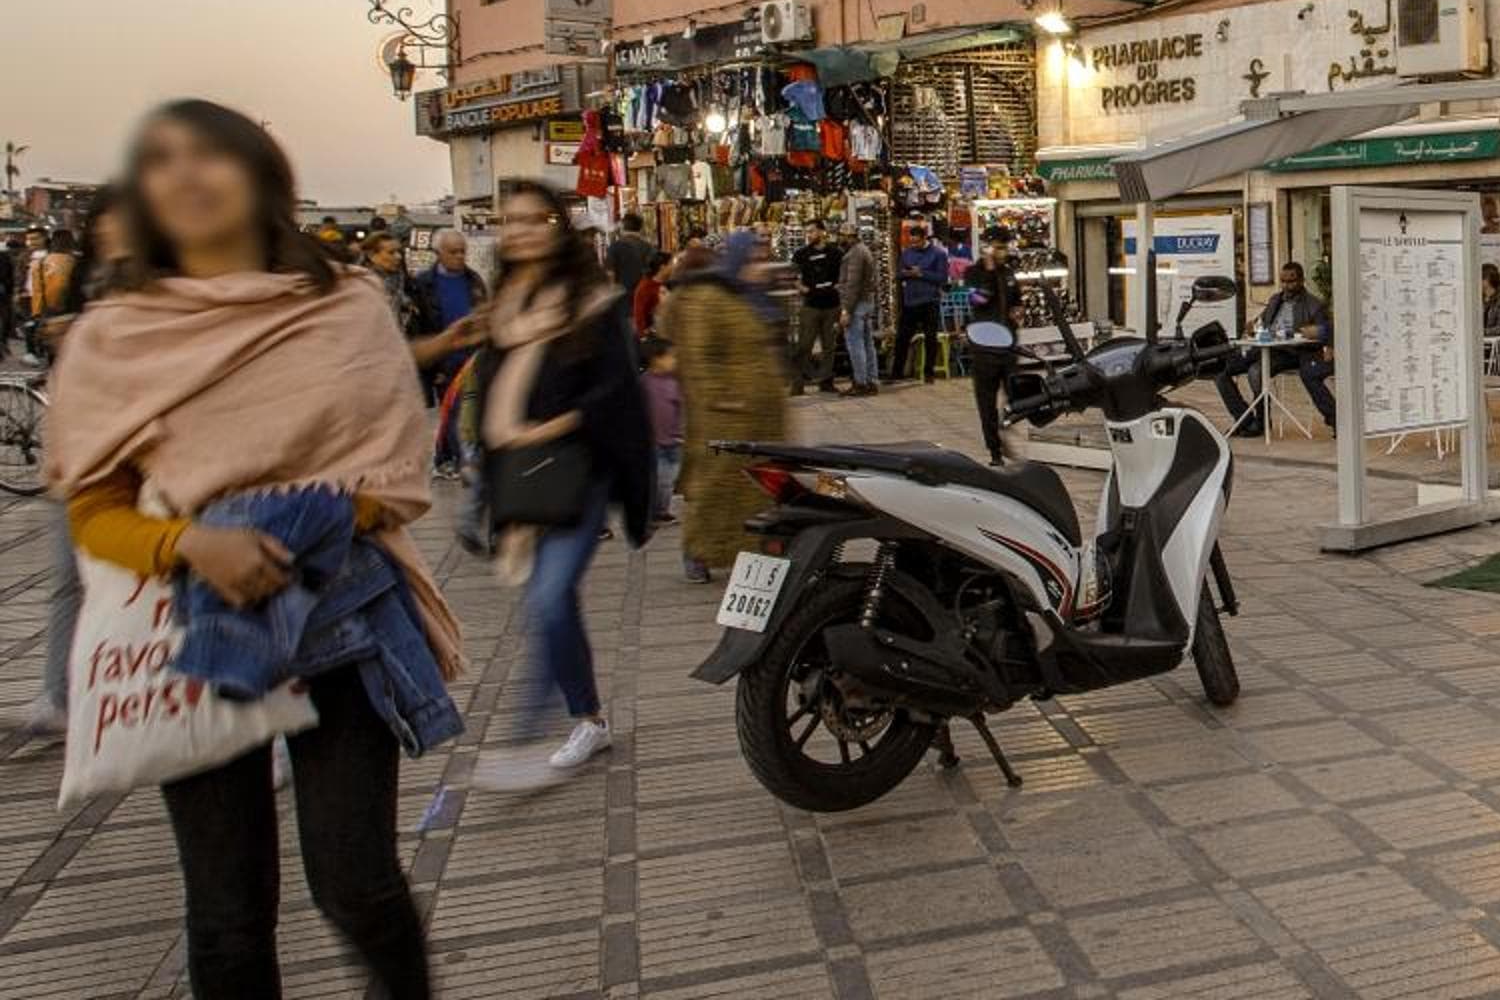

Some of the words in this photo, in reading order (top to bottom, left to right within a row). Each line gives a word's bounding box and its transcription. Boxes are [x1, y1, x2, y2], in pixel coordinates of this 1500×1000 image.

[1092, 33, 1203, 71] PHARMACIE
[1137, 63, 1158, 81] DU
[1102, 77, 1196, 110] PROGRES
